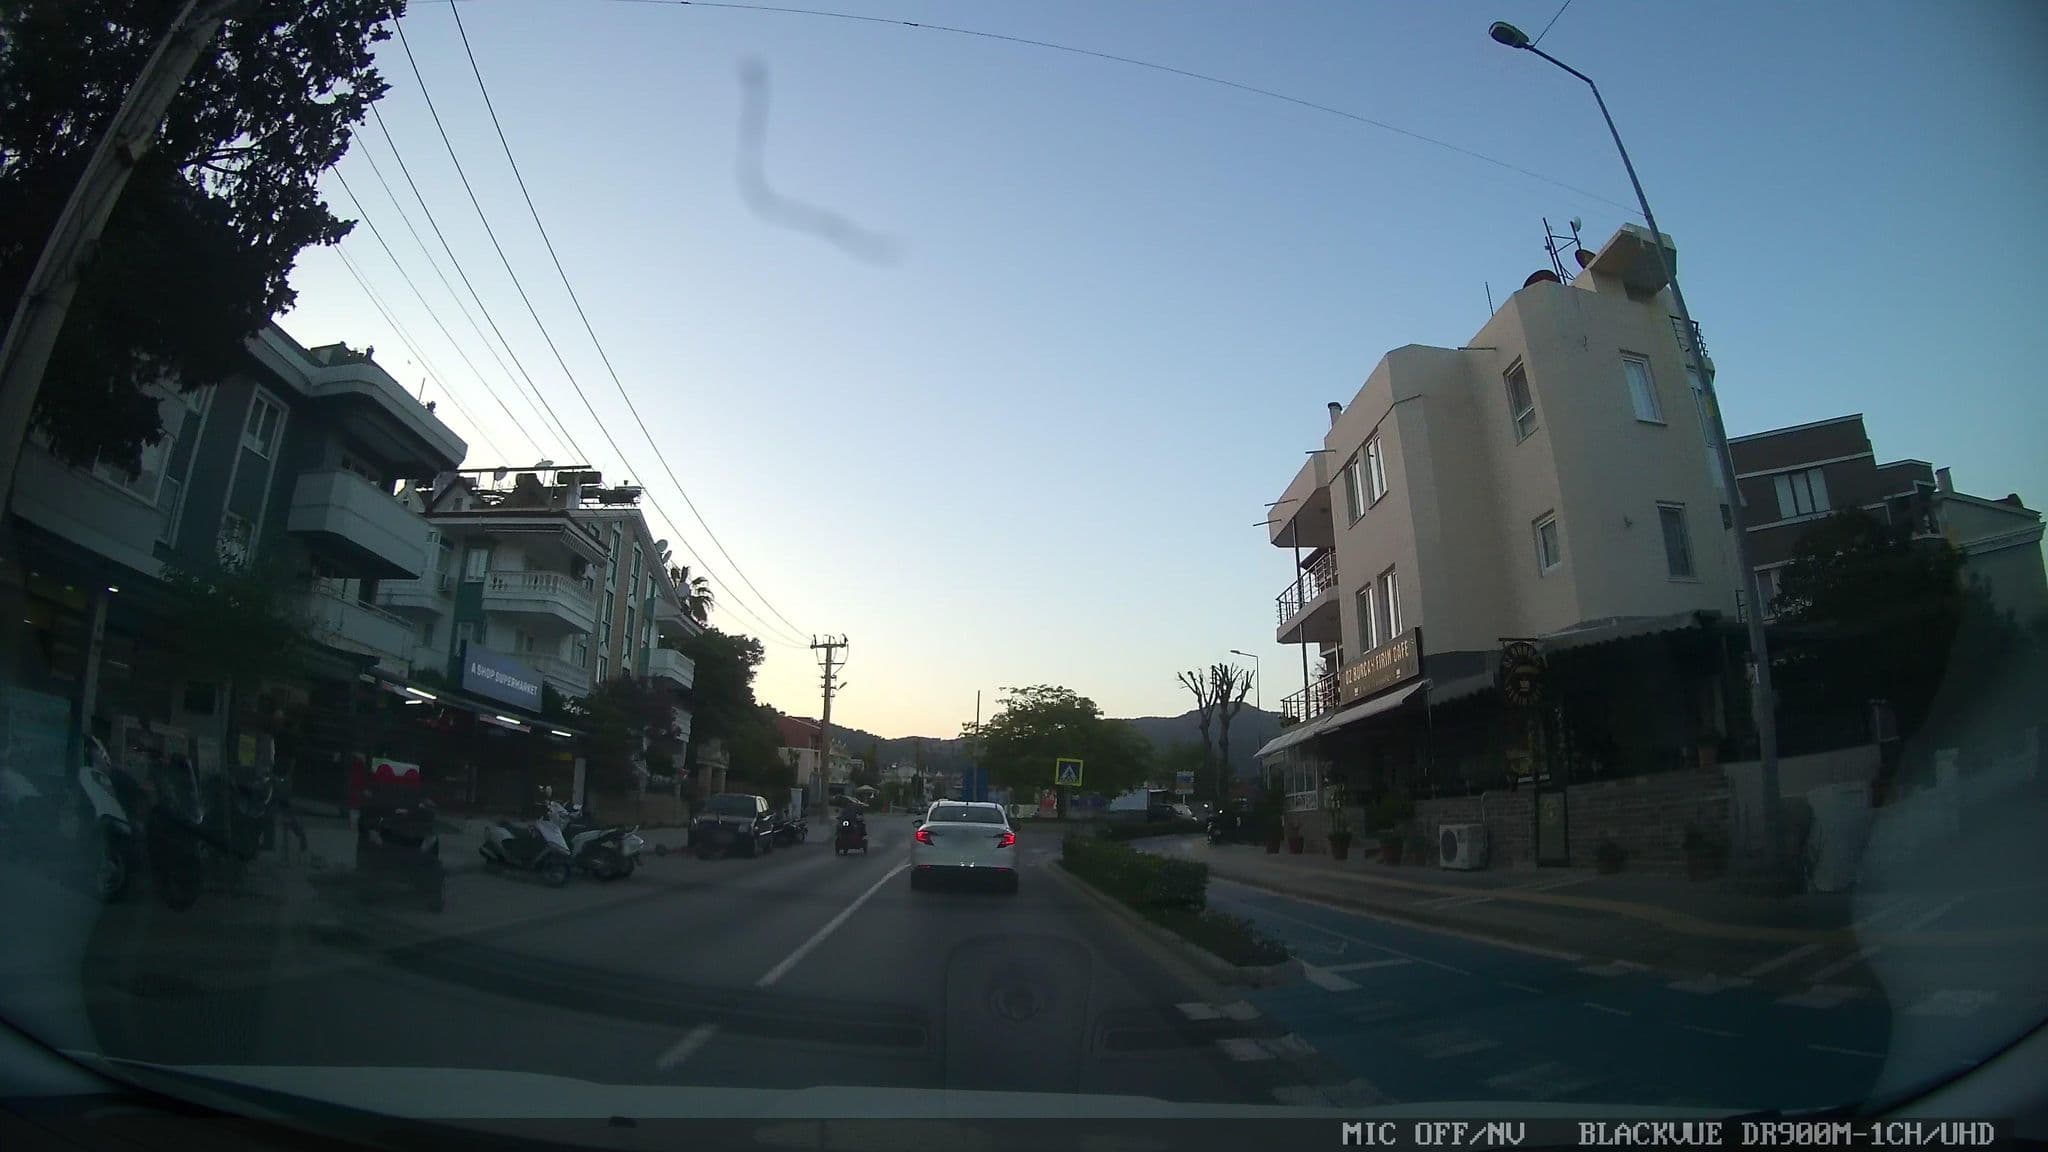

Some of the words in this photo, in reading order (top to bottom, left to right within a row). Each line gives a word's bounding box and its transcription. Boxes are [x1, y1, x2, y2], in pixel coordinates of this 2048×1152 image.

[1392, 640, 1409, 663] CAFE
[476, 664, 496, 681] SHOP
[495, 671, 539, 697] SUPERMARKET
